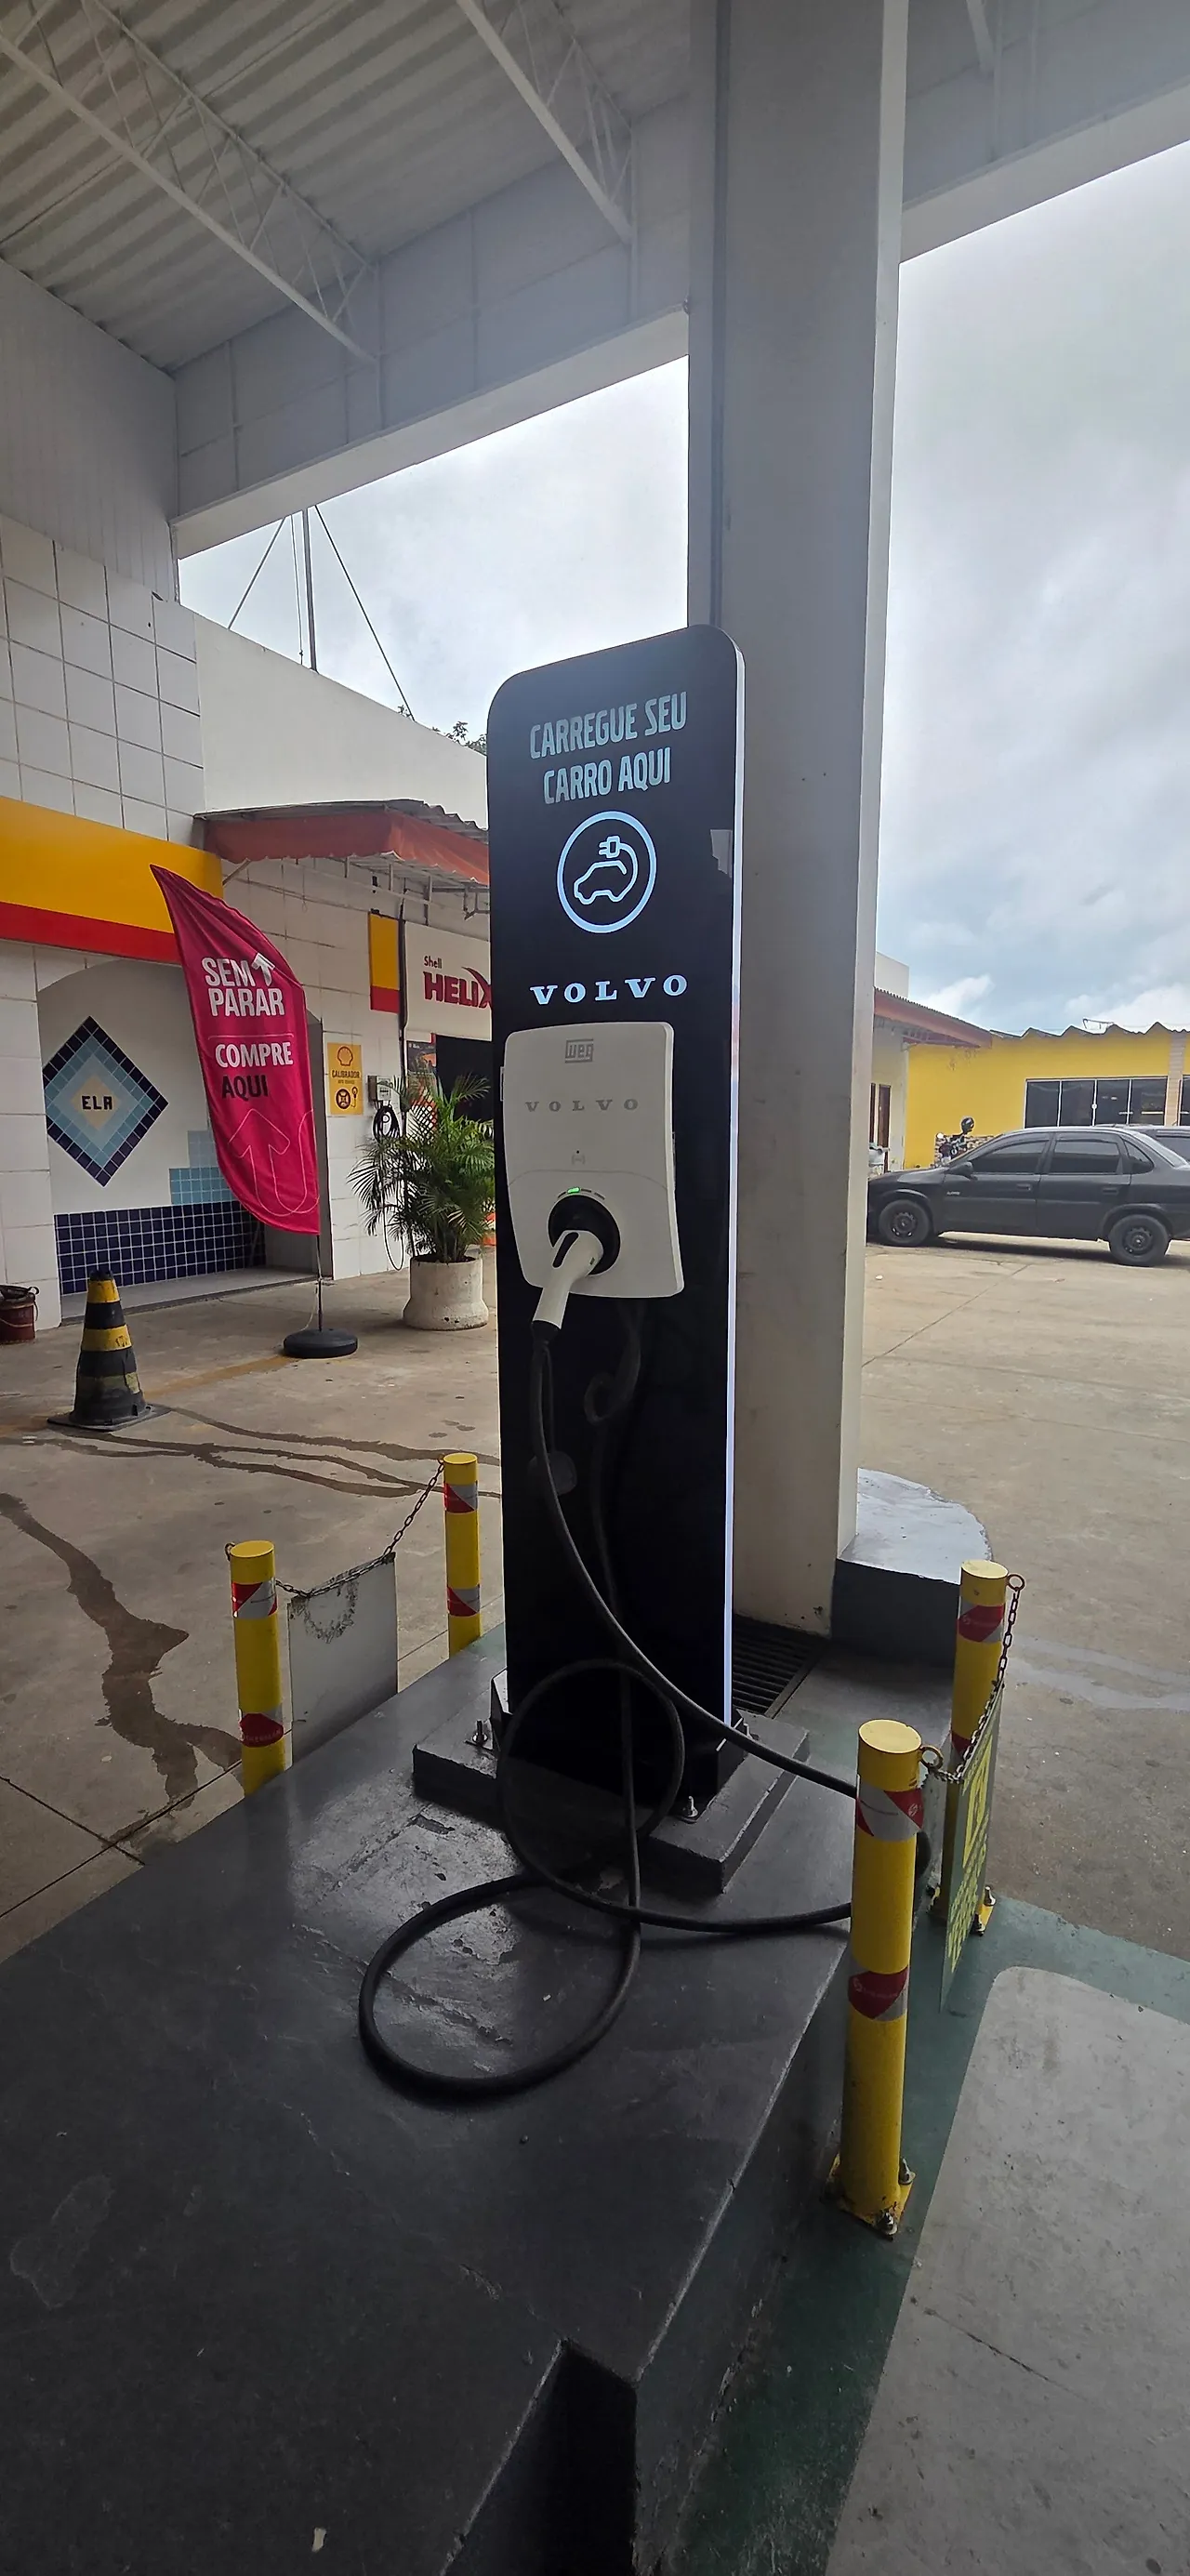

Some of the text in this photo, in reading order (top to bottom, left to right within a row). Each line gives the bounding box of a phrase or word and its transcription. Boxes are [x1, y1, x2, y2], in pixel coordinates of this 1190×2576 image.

[530, 691, 687, 760] CARREGUE SEU
[543, 746, 671, 805] CARRO AQUI
[201, 957, 256, 987] SEM
[424, 956, 443, 970] Shell
[207, 988, 285, 1017] PARAR
[529, 974, 688, 1005] VOLVO
[215, 1042, 294, 1068] COMPRE
[221, 1074, 269, 1102] AQUI
[524, 1098, 639, 1113] VOLVO
